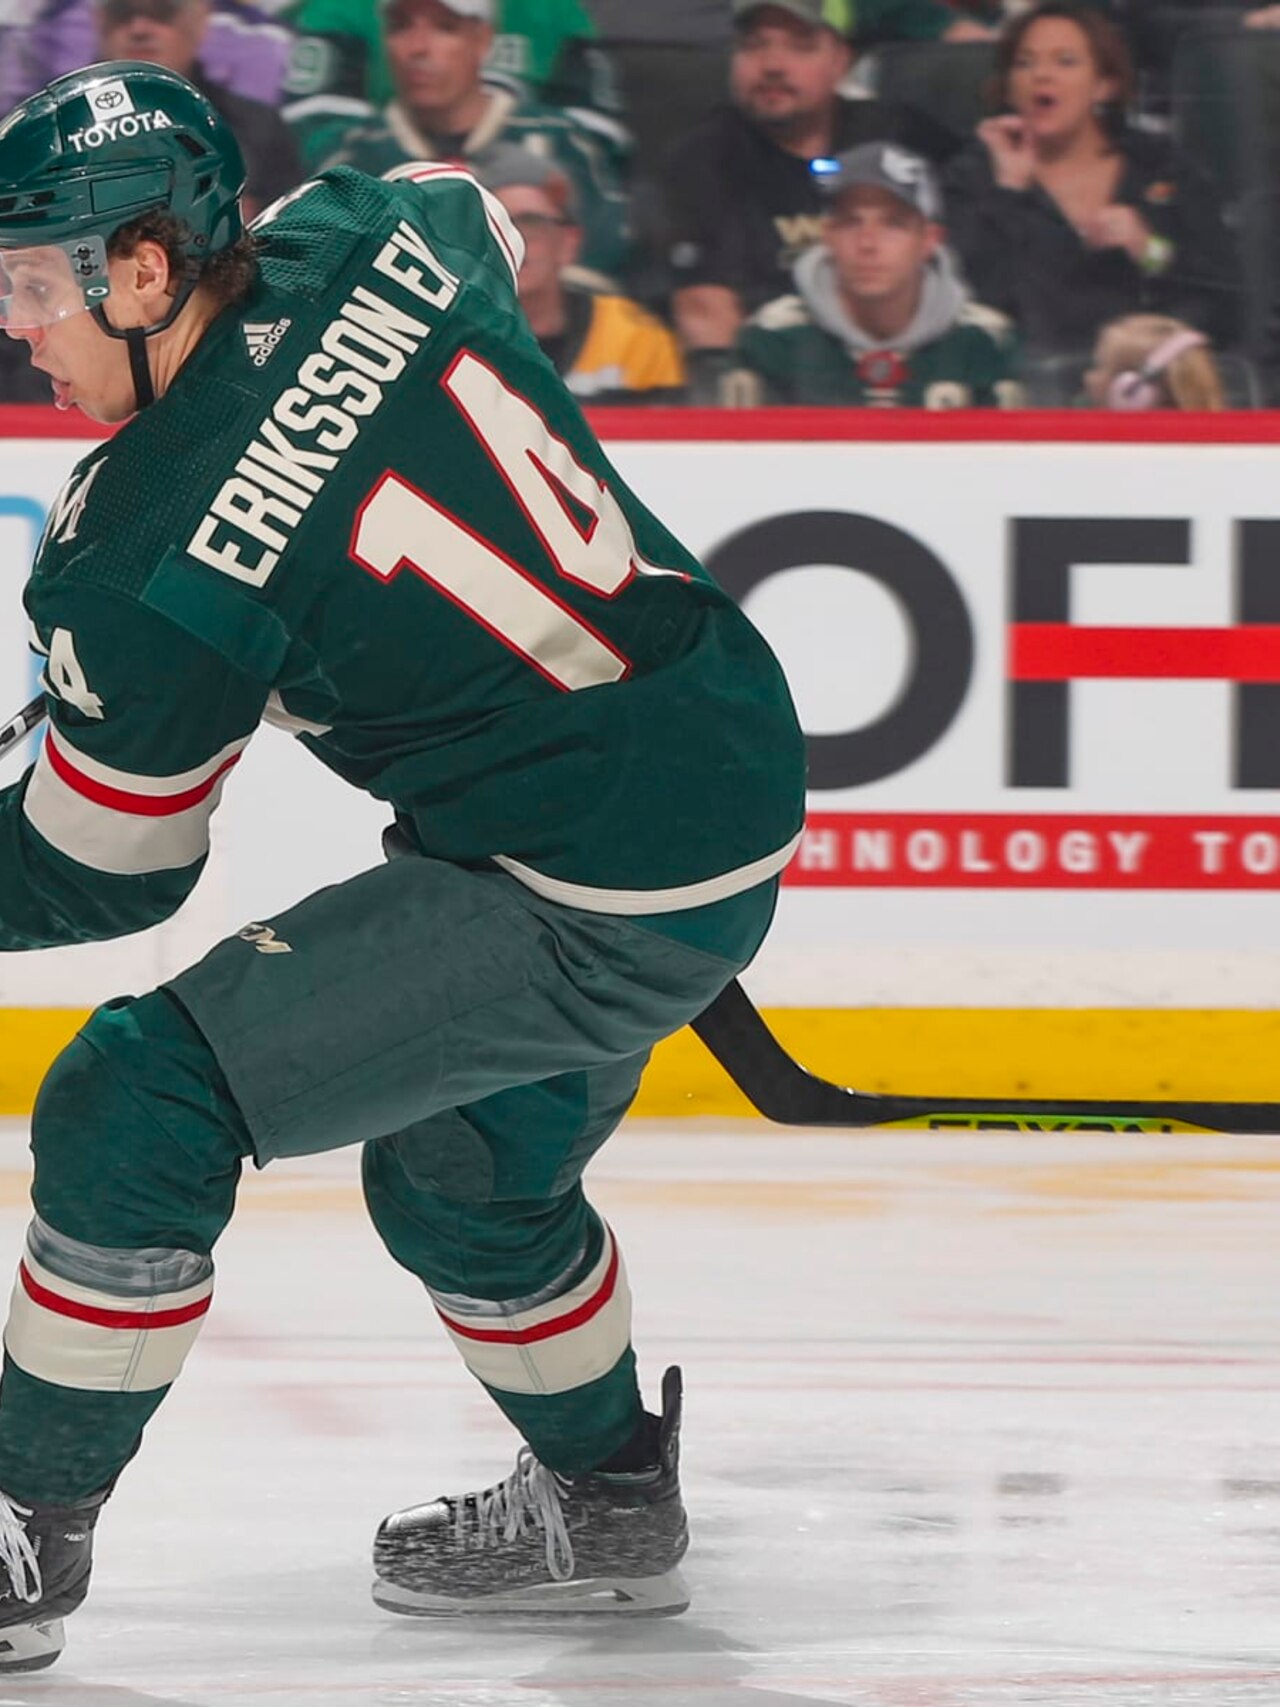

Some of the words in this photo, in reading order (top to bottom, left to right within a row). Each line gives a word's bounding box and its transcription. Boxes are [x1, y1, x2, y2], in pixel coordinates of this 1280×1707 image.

[67, 109, 173, 153] TOYOTA
[253, 317, 292, 367] adidas
[185, 285, 431, 589] ERIKSSON
[347, 346, 692, 694] 14
